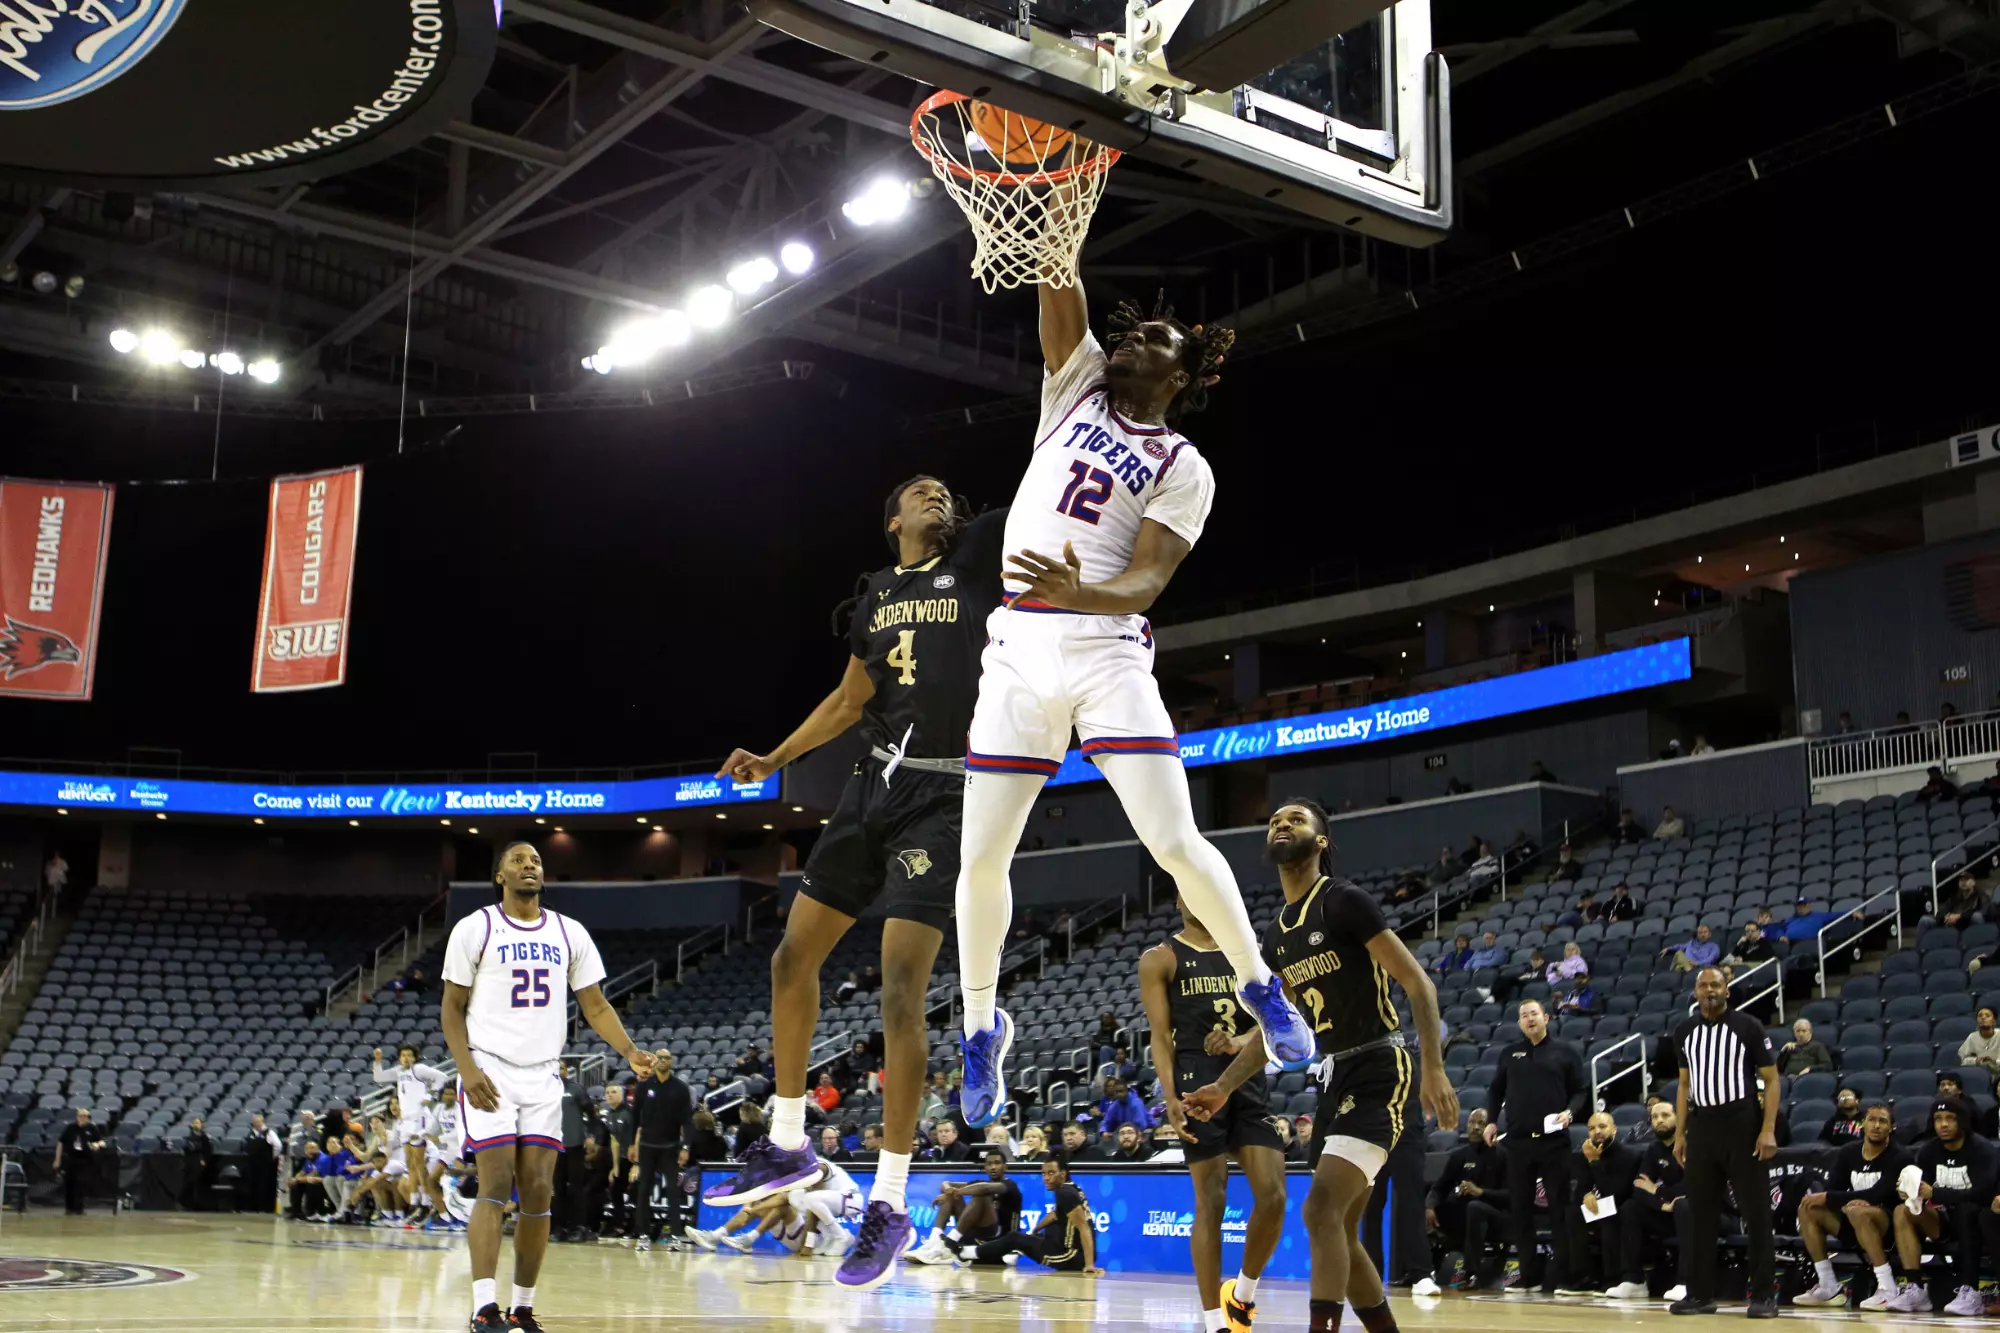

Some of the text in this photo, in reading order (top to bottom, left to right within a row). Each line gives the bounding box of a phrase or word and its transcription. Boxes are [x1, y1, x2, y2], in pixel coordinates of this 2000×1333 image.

[1063, 422, 1153, 496] TIGERS
[1056, 459, 1113, 525] 12
[29, 496, 65, 612] REDHAWKS
[300, 480, 327, 604] COUGARS
[271, 621, 341, 659] SIUE
[885, 630, 917, 685] 4
[1944, 666, 1967, 681] 105
[1179, 707, 1430, 760] our New Kentucky Home
[1429, 756, 1443, 767] 104
[58, 790, 116, 802] KENTUCKY
[64, 782, 93, 791] TEAM
[676, 788, 721, 801] KENTUCKY
[680, 781, 702, 791] TEAM
[253, 788, 604, 815] Come visit our New Kentucky Home
[497, 942, 561, 965] TIGERS
[511, 968, 550, 1008] 25
[1181, 975, 1236, 996] LINDENW
[1213, 998, 1237, 1038] 3
[1302, 987, 1333, 1034] 2
[1142, 1223, 1193, 1237] KENTUCK
[1148, 1211, 1176, 1223] TEAM
